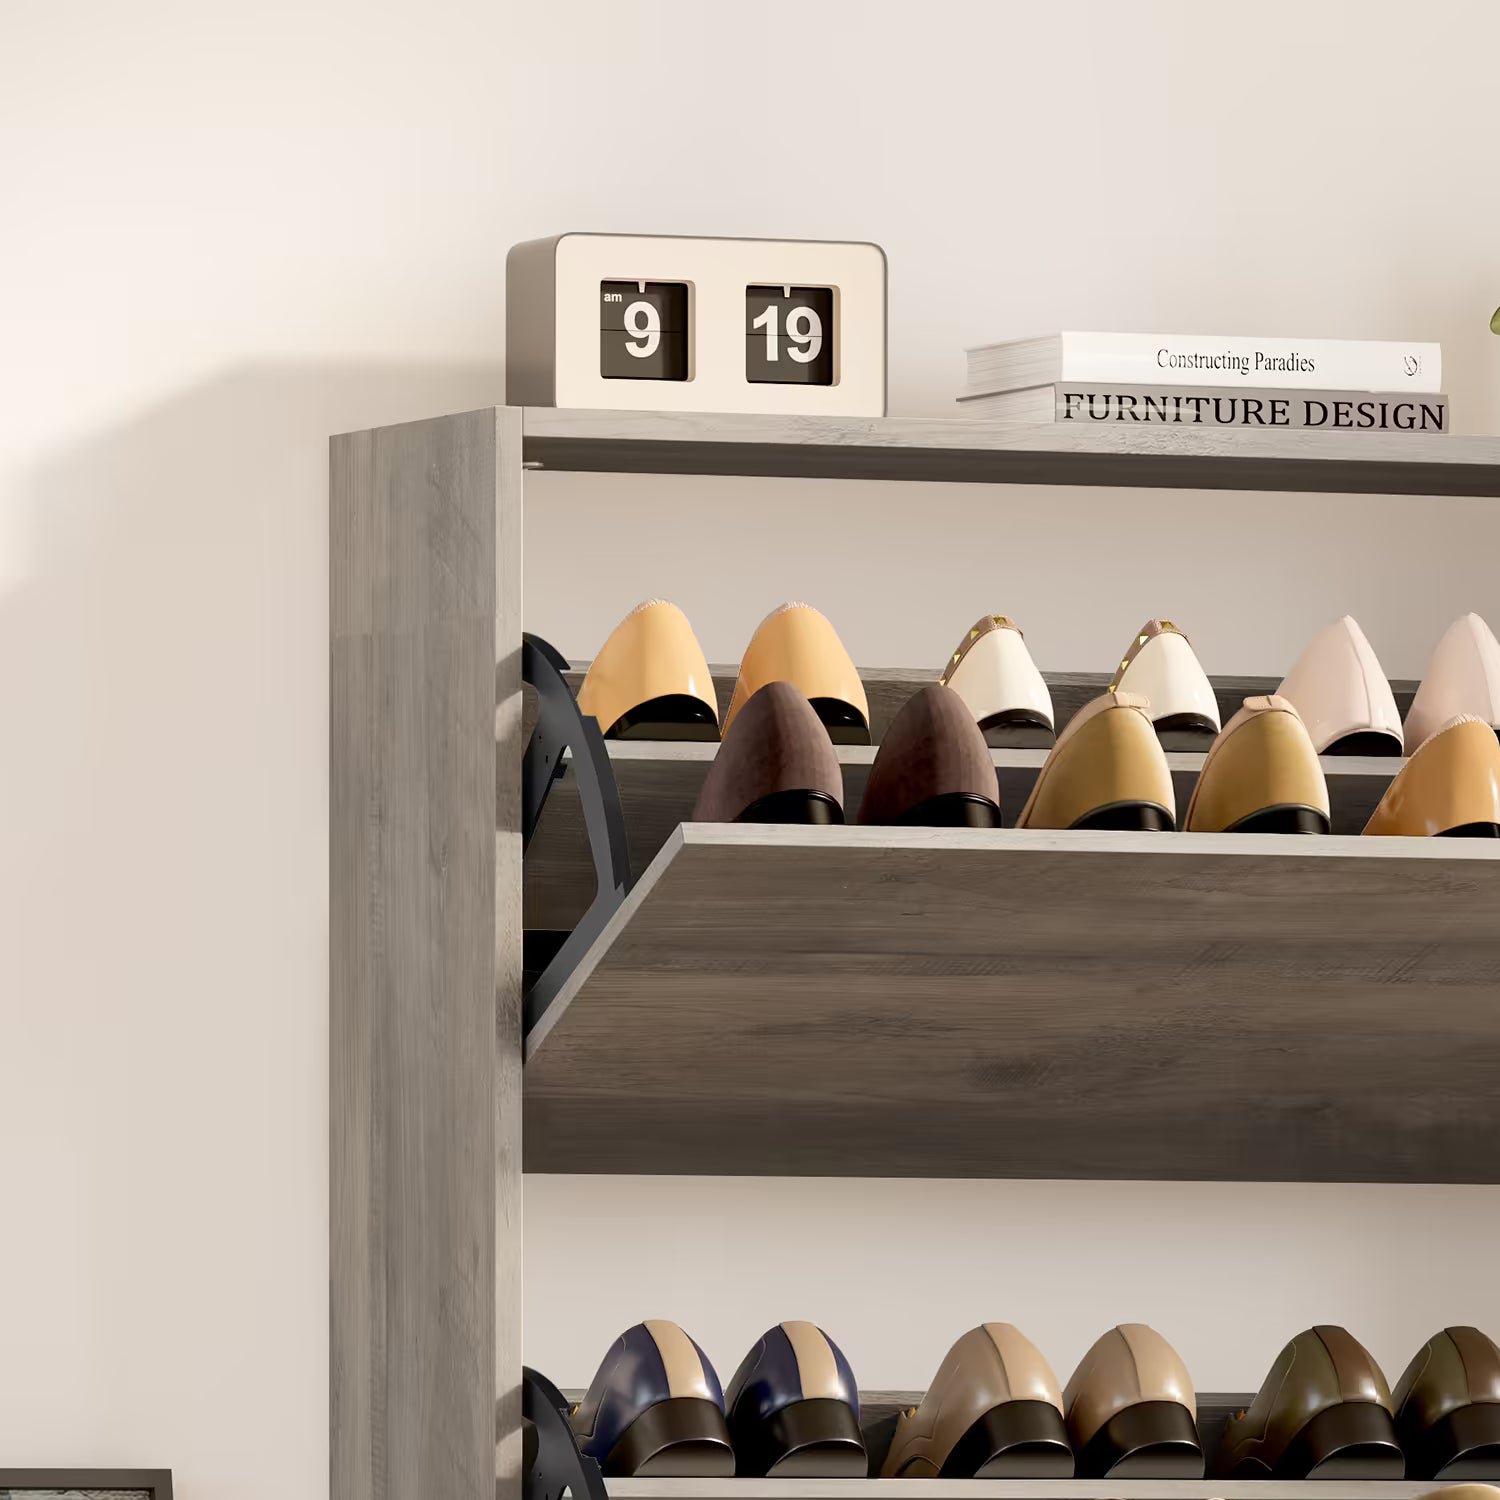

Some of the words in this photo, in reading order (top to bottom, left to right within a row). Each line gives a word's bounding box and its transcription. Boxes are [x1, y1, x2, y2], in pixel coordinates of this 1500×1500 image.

[603, 293, 622, 302] am
[623, 301, 661, 358] 9
[752, 305, 823, 363] 19
[1157, 348, 1250, 376] Constructing
[1255, 351, 1315, 373] Paradies
[1063, 393, 1290, 425] FURNITURE
[1303, 400, 1445, 431] DESIGN
